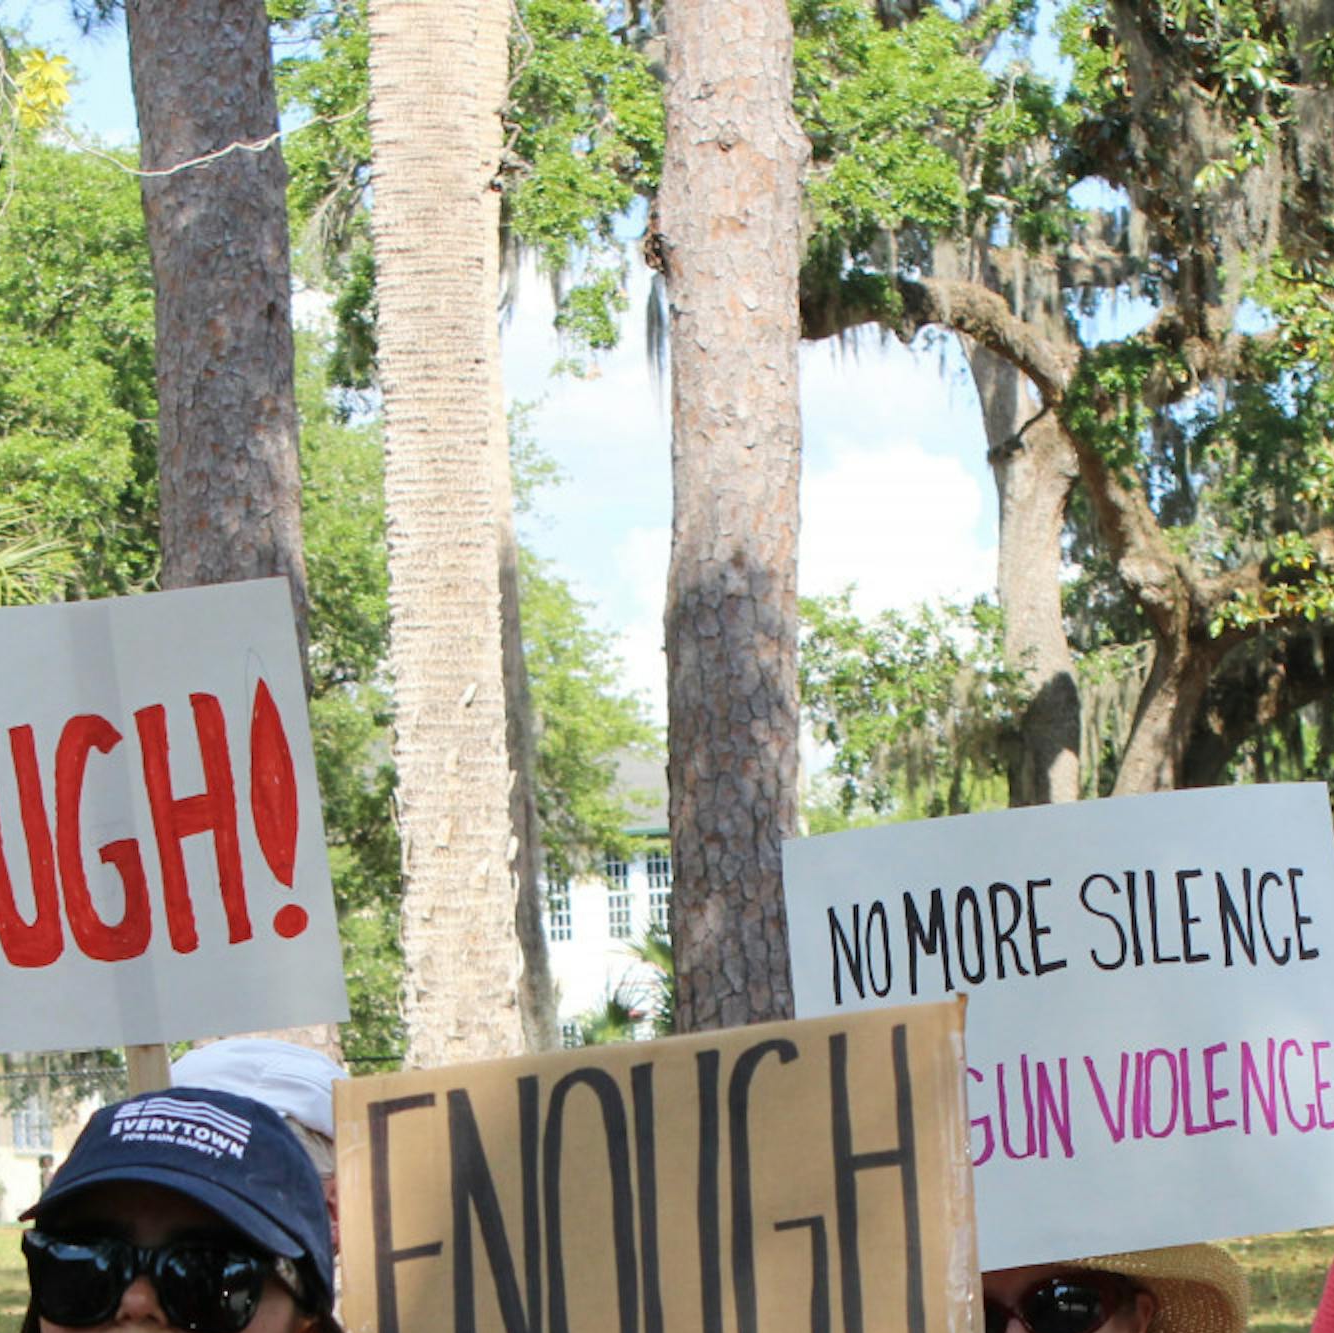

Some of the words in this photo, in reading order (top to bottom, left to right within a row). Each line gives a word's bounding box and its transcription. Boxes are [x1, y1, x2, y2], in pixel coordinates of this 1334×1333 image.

[827, 900, 892, 1006] NO
[903, 877, 1068, 996] MORE
[1079, 867, 1319, 971] SILENCE
[110, 1117, 245, 1160] EVERYTOWN
